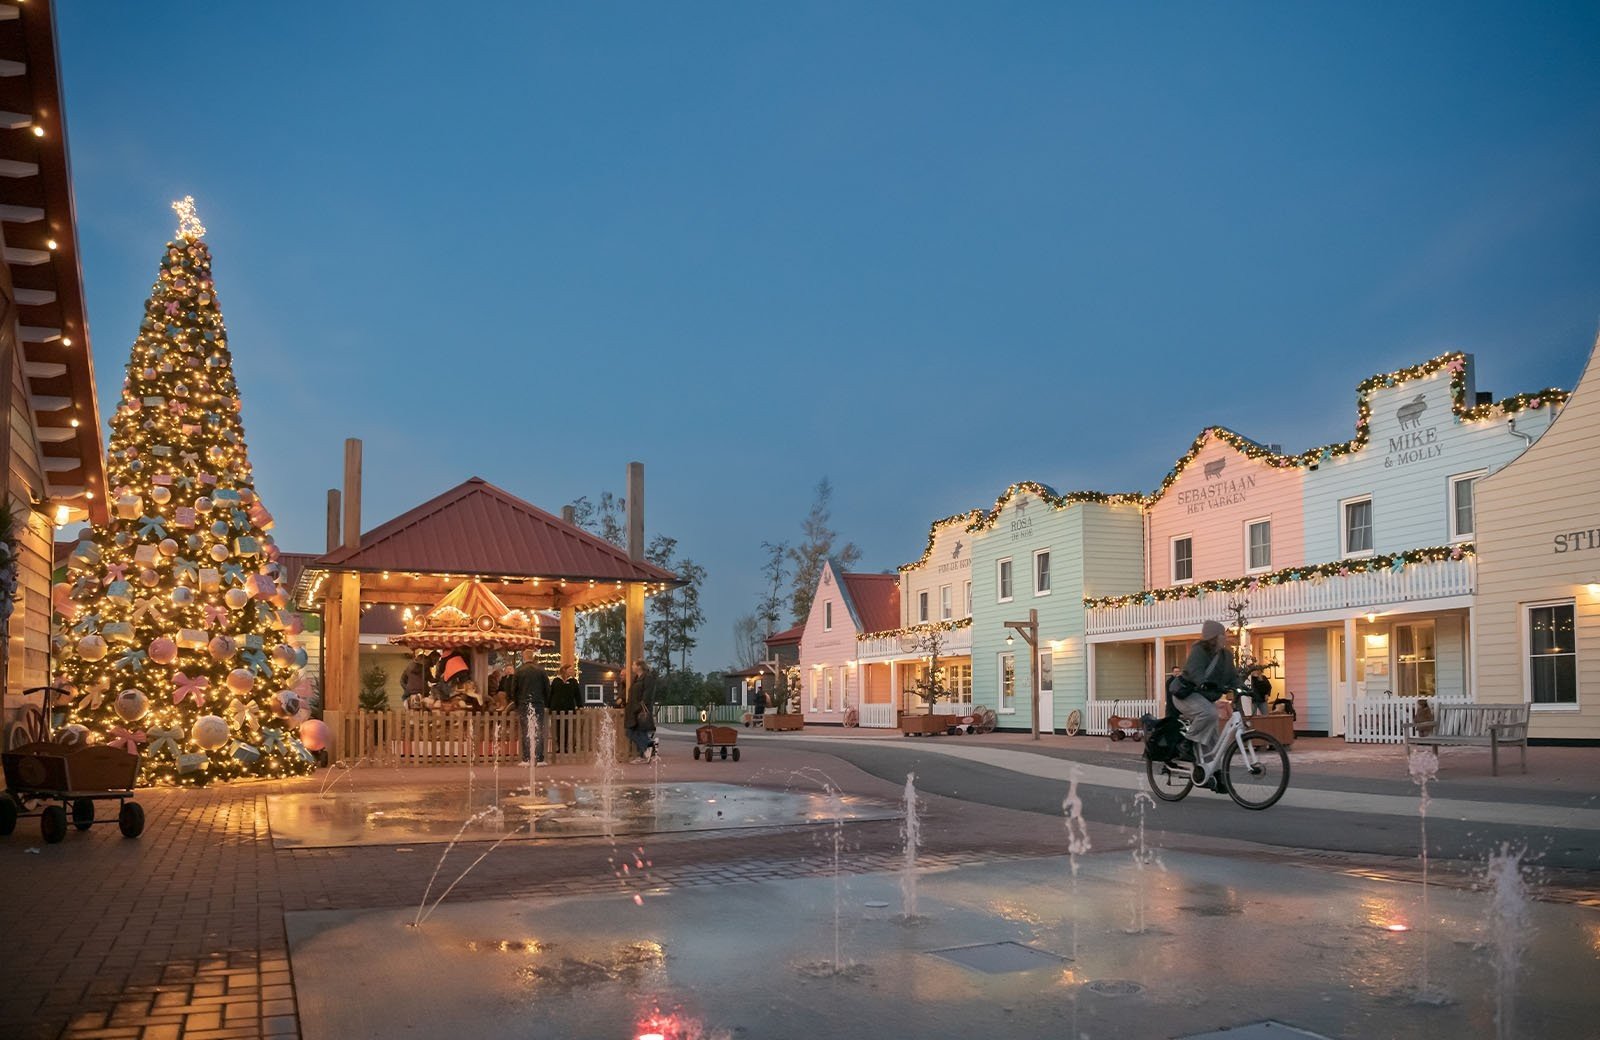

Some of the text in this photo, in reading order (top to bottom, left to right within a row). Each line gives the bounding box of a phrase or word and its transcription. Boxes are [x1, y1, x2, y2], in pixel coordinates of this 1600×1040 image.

[1389, 427, 1437, 453] MIKE
[1384, 443, 1443, 468] & MOLLY
[1177, 473, 1256, 505] SEBASTIAAN
[1187, 491, 1246, 515] HET VARKEN
[1010, 516, 1033, 532] ROSA
